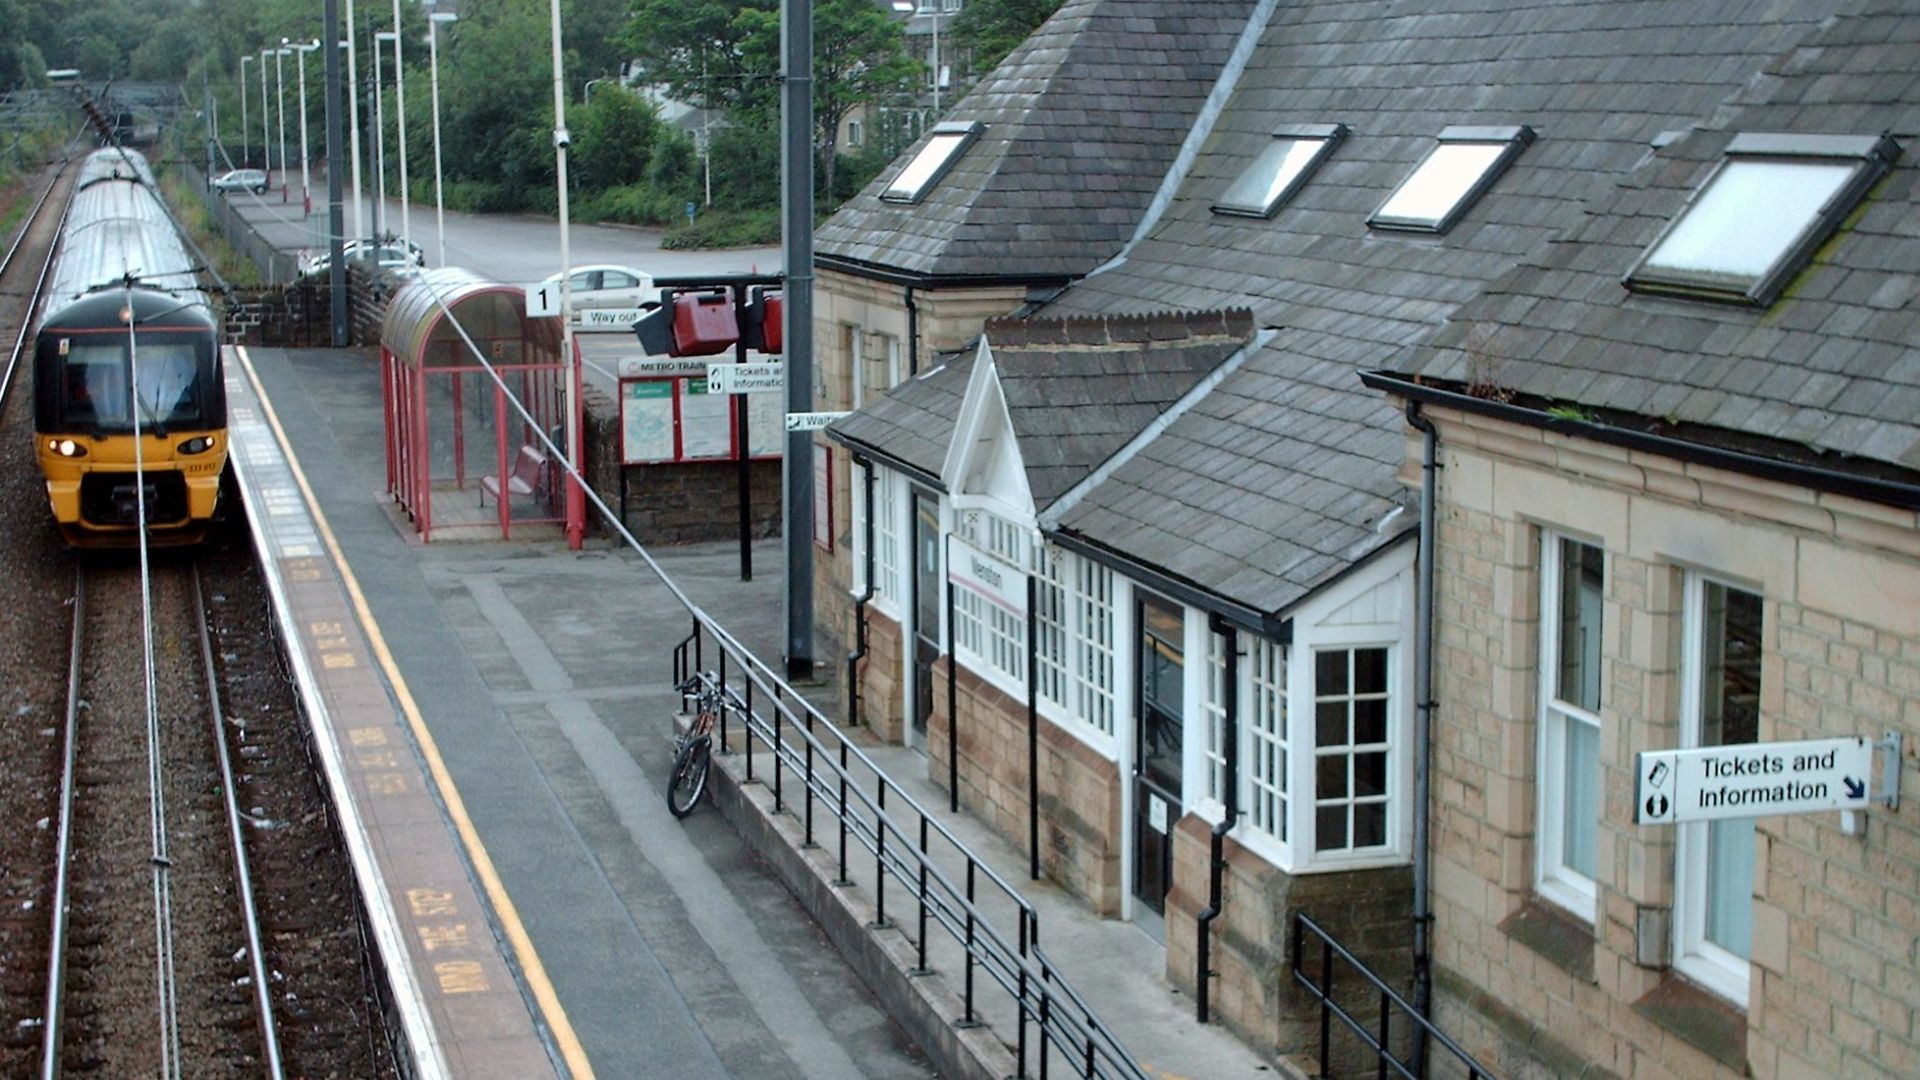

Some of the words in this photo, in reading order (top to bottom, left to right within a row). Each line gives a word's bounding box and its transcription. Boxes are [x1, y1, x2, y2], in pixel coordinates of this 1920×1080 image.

[538, 288, 548, 311] 1
[590, 311, 616, 323] Way
[619, 312, 637, 322] out
[640, 362, 675, 372] METRO
[735, 367, 769, 377] Tickets
[734, 379, 783, 389] Informatio
[806, 415, 832, 426] Wait
[1702, 754, 1784, 778] Tickets
[1792, 750, 1836, 771] and
[1700, 781, 1828, 807] Information
